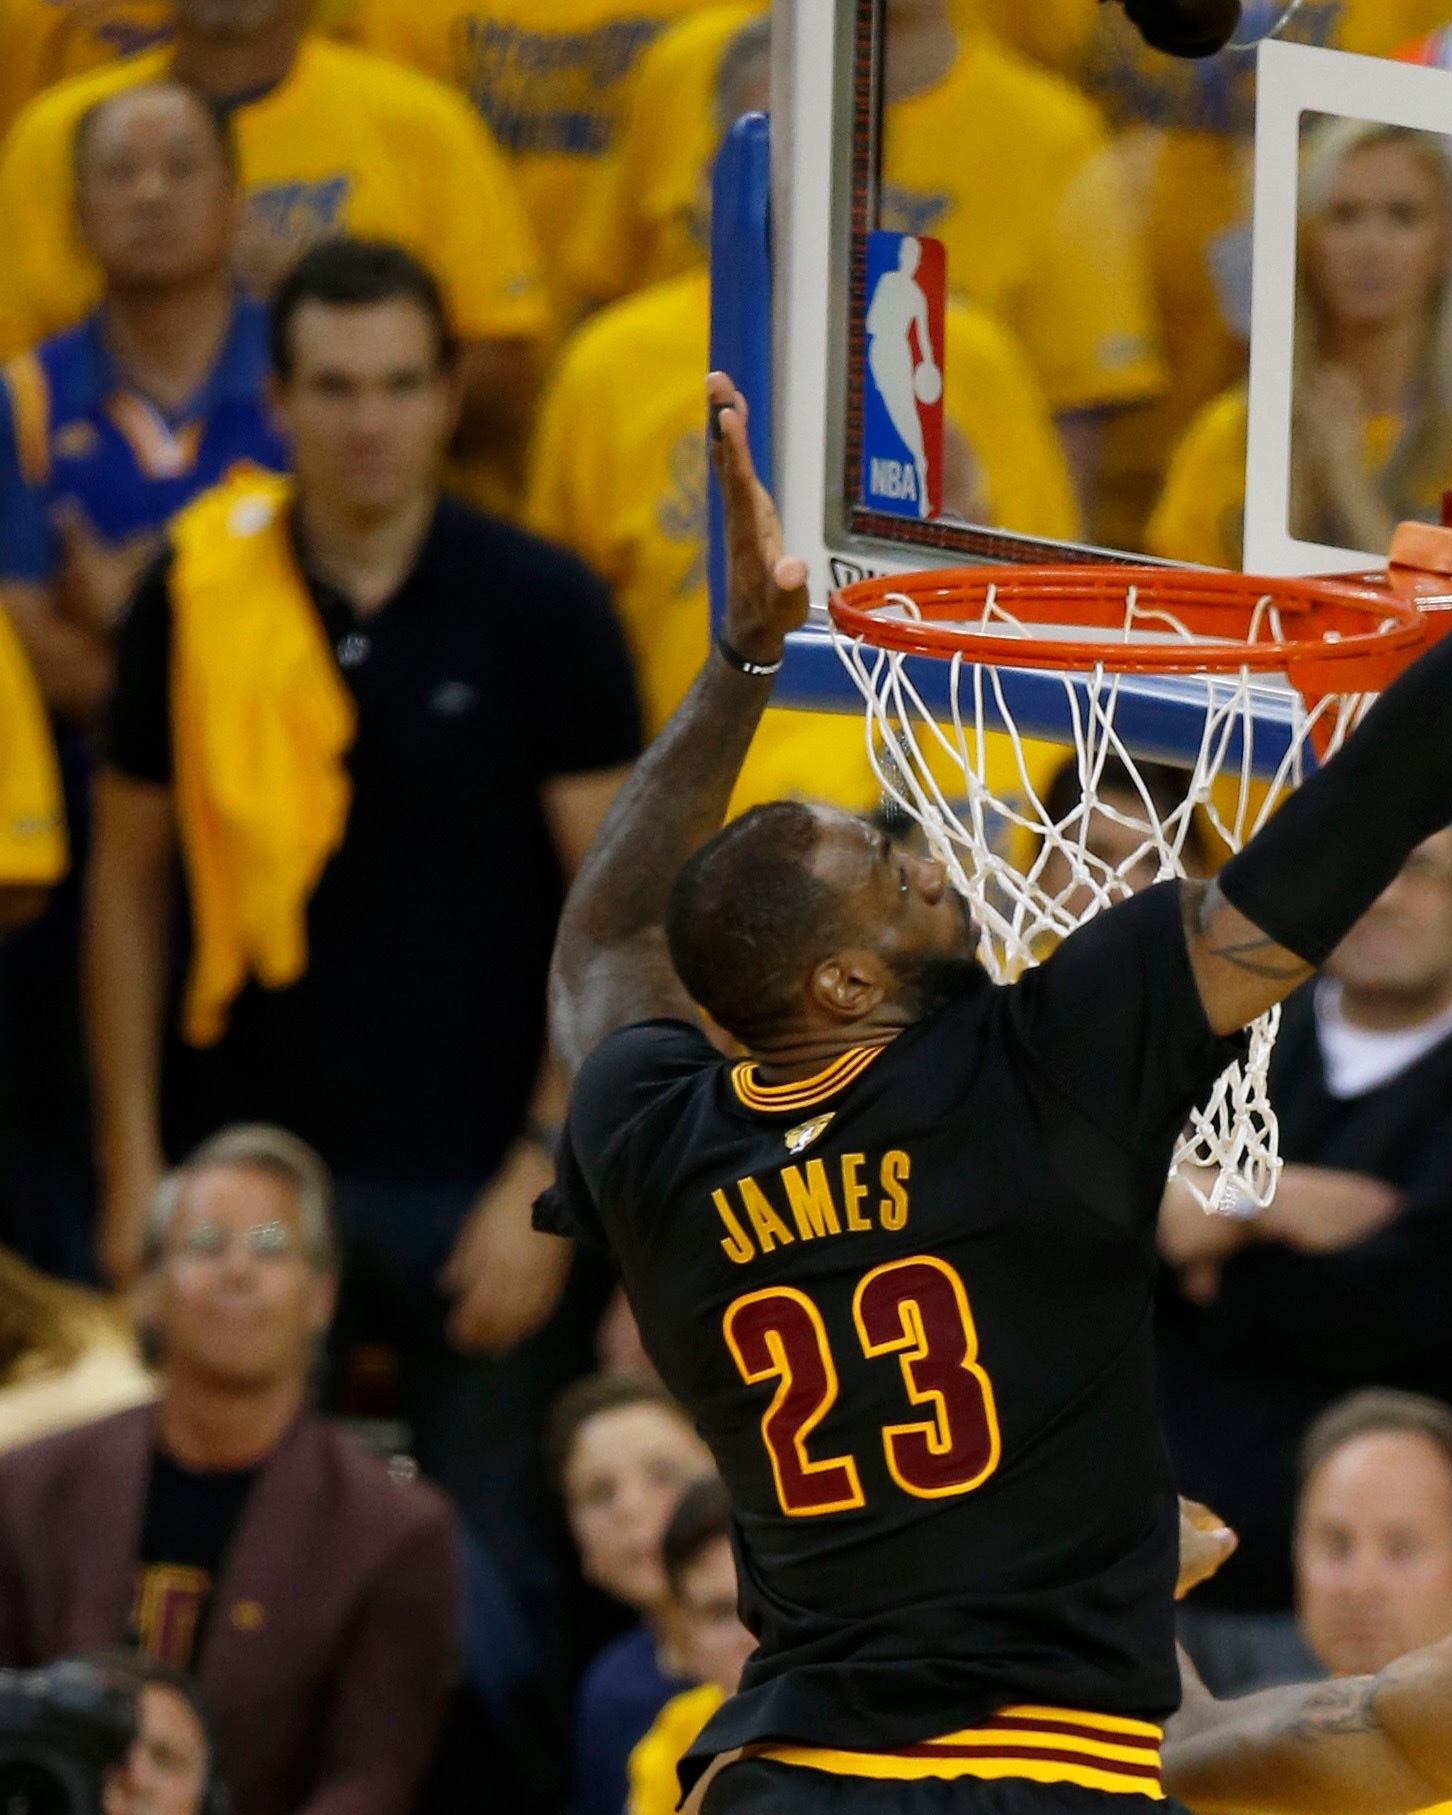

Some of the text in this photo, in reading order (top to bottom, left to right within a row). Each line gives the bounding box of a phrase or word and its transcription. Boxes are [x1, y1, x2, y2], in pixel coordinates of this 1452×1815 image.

[870, 457, 918, 502] NBA
[711, 1150, 911, 1264] JAMES
[722, 1254, 1001, 1517] 23
